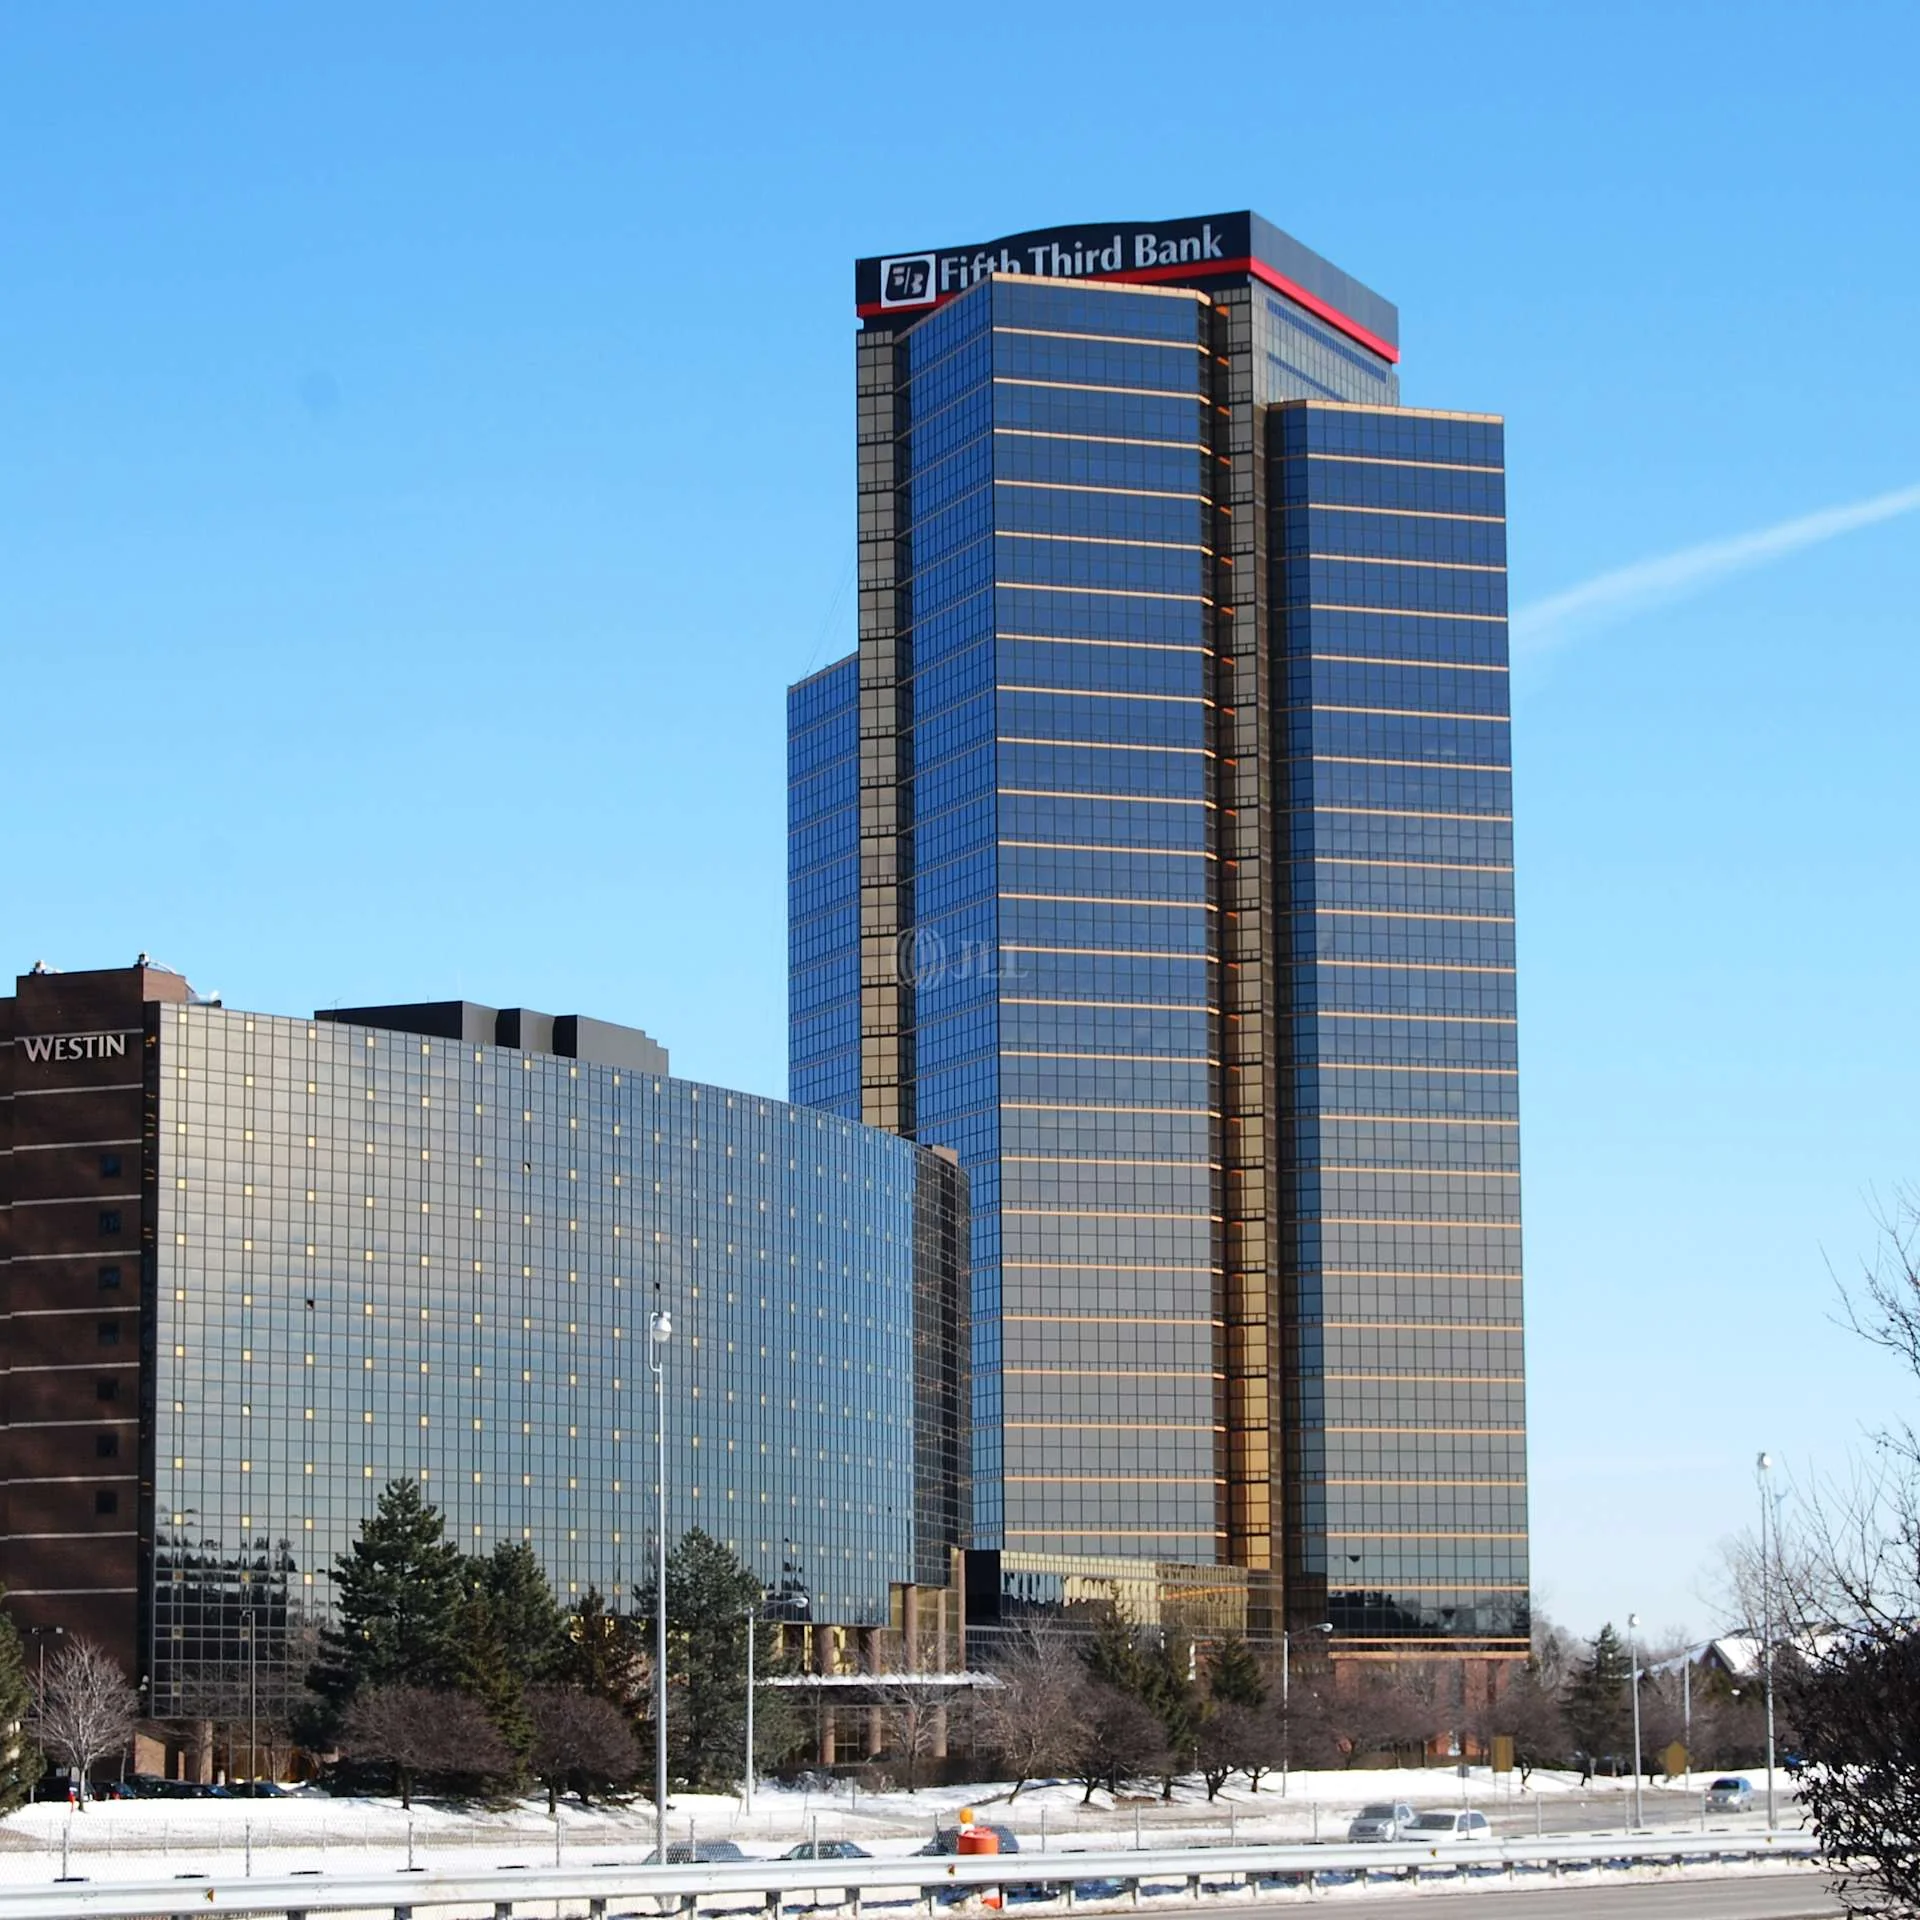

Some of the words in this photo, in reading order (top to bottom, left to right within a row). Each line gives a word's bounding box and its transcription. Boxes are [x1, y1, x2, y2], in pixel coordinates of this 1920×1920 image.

[940, 248, 1021, 292] Fifth
[1027, 234, 1122, 277] Third
[1134, 223, 1223, 268] Bank
[23, 1034, 126, 1062] WESTIN
